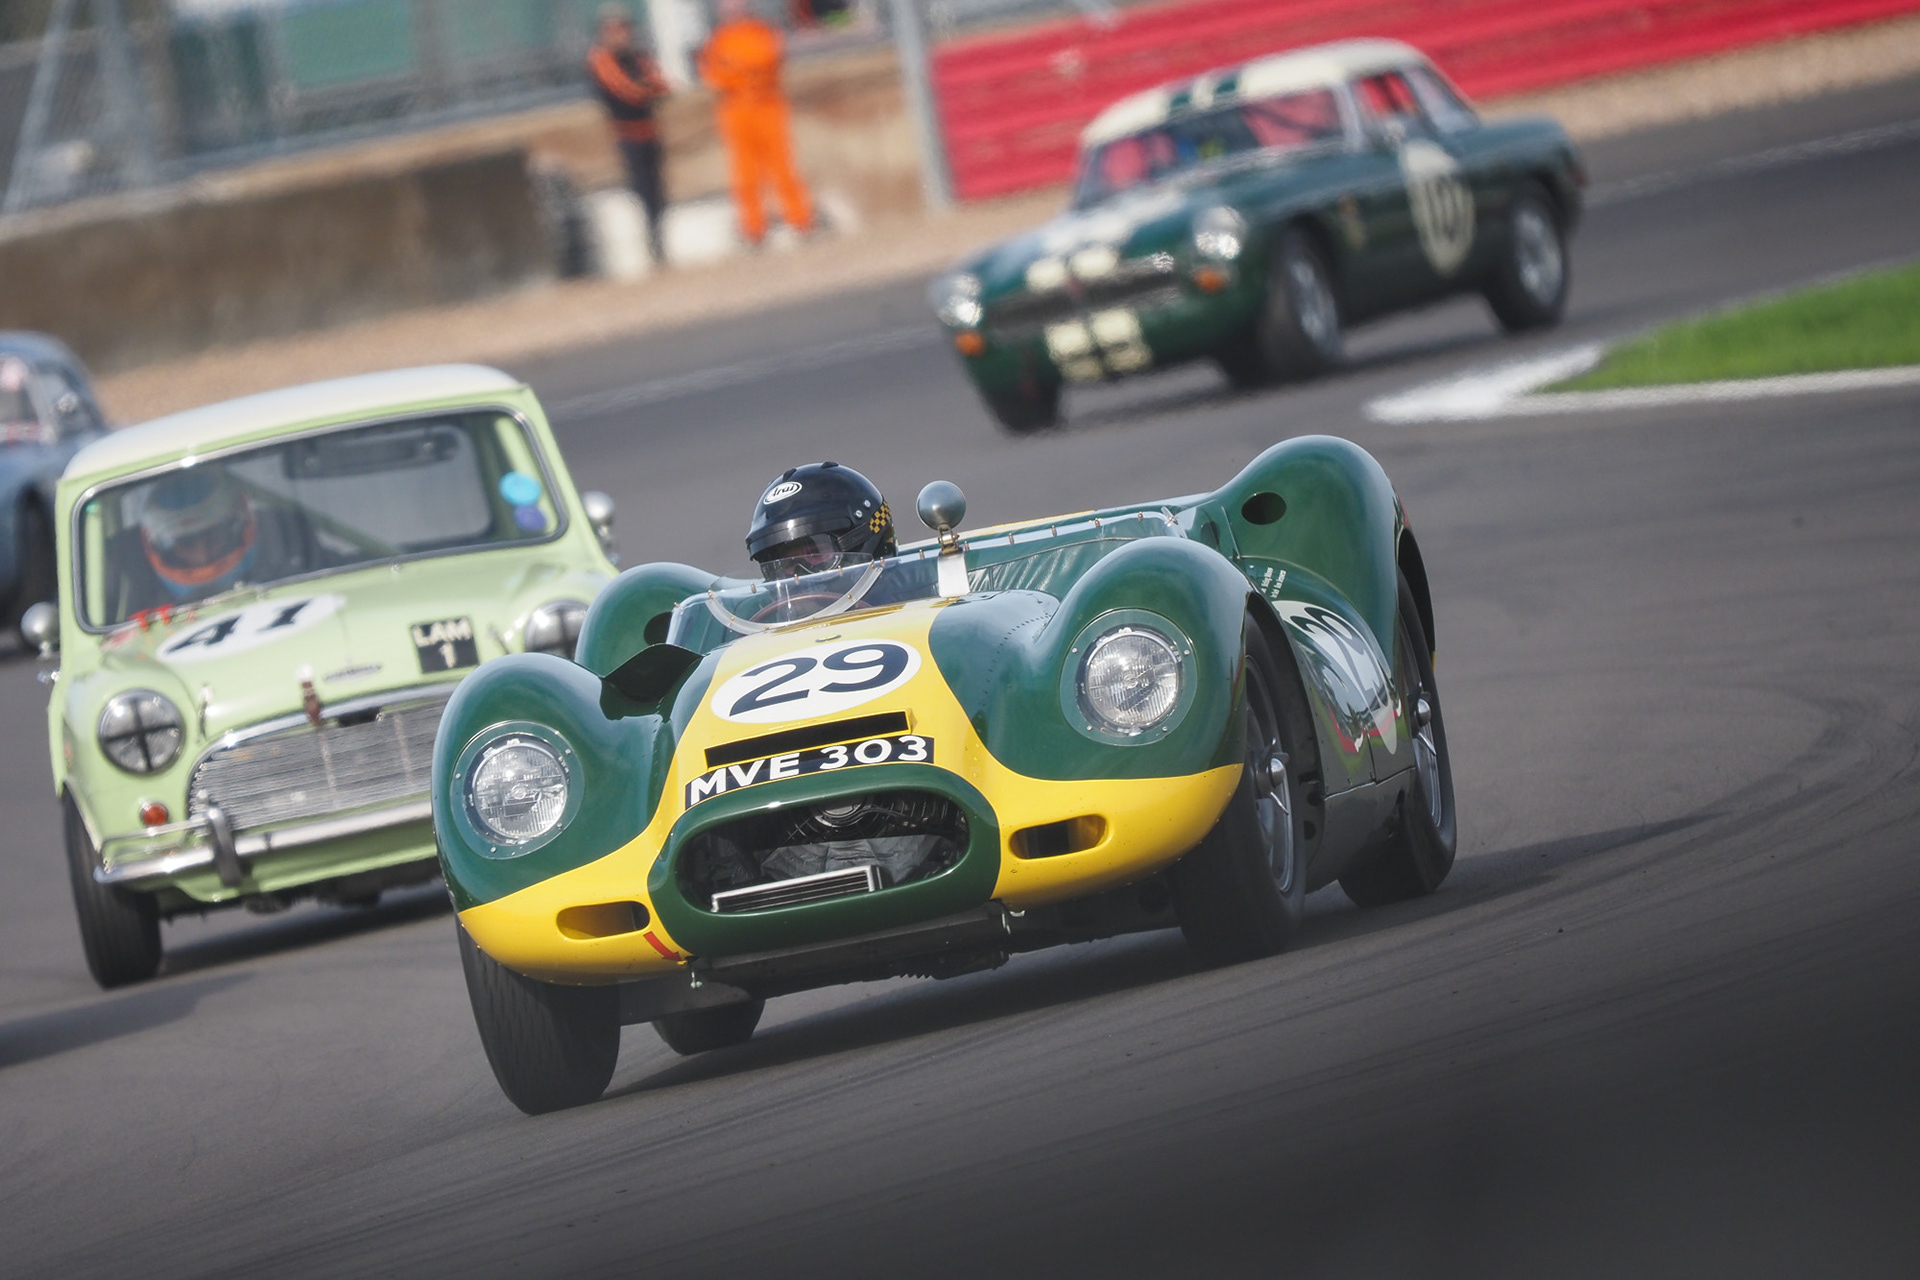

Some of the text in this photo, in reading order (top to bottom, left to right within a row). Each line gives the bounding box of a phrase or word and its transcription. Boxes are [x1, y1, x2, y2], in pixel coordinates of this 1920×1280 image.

[413, 616, 473, 648] LAM
[729, 643, 909, 717] 29
[690, 735, 928, 807] MVE 303
